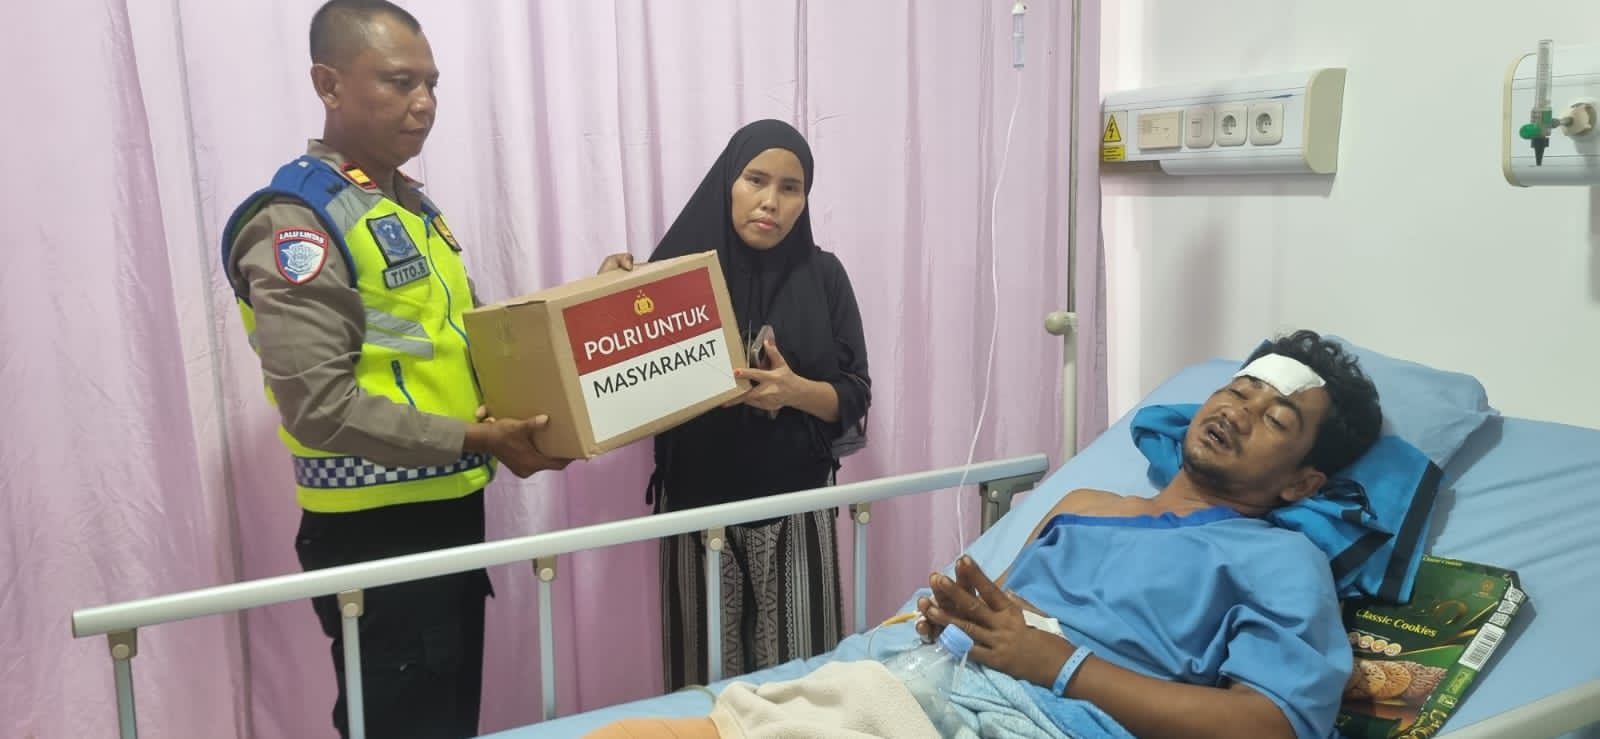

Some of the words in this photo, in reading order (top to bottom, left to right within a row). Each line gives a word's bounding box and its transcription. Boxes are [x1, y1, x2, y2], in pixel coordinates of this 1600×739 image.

[279, 231, 300, 240] LALU
[584, 325, 643, 360] POLRI
[645, 305, 709, 339] UNTUK
[593, 339, 717, 398] MASYARAKAT
[1355, 608, 1393, 625] Classic
[1393, 617, 1438, 638] Cookies
